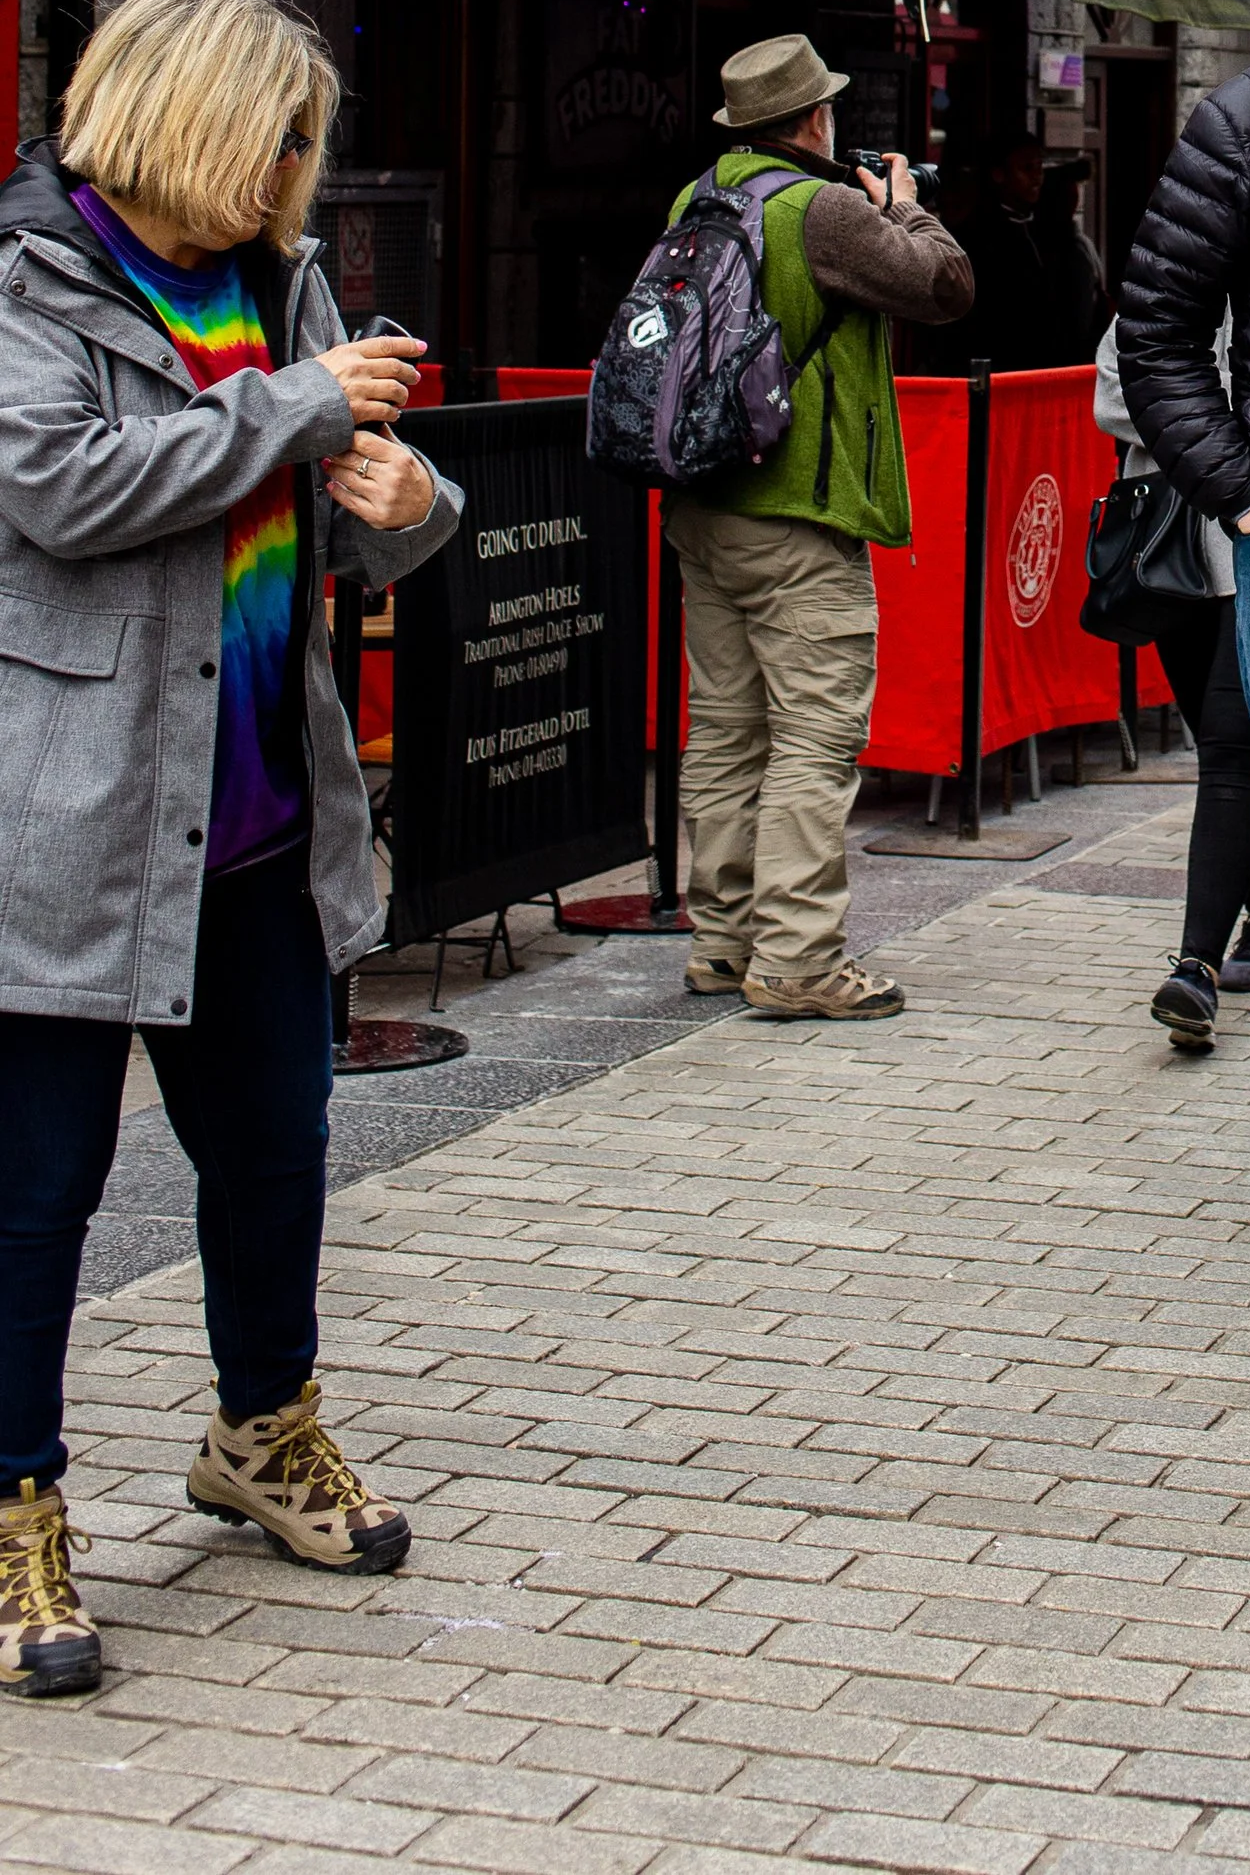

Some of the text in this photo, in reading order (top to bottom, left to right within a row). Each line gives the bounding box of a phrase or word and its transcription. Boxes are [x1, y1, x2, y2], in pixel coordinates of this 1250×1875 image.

[596, 8, 648, 56] FAT
[477, 526, 519, 559] GOING
[520, 523, 537, 550] TO
[488, 592, 543, 627] ARLINGTON
[546, 619, 572, 643] DACE
[575, 612, 605, 637] SHOW
